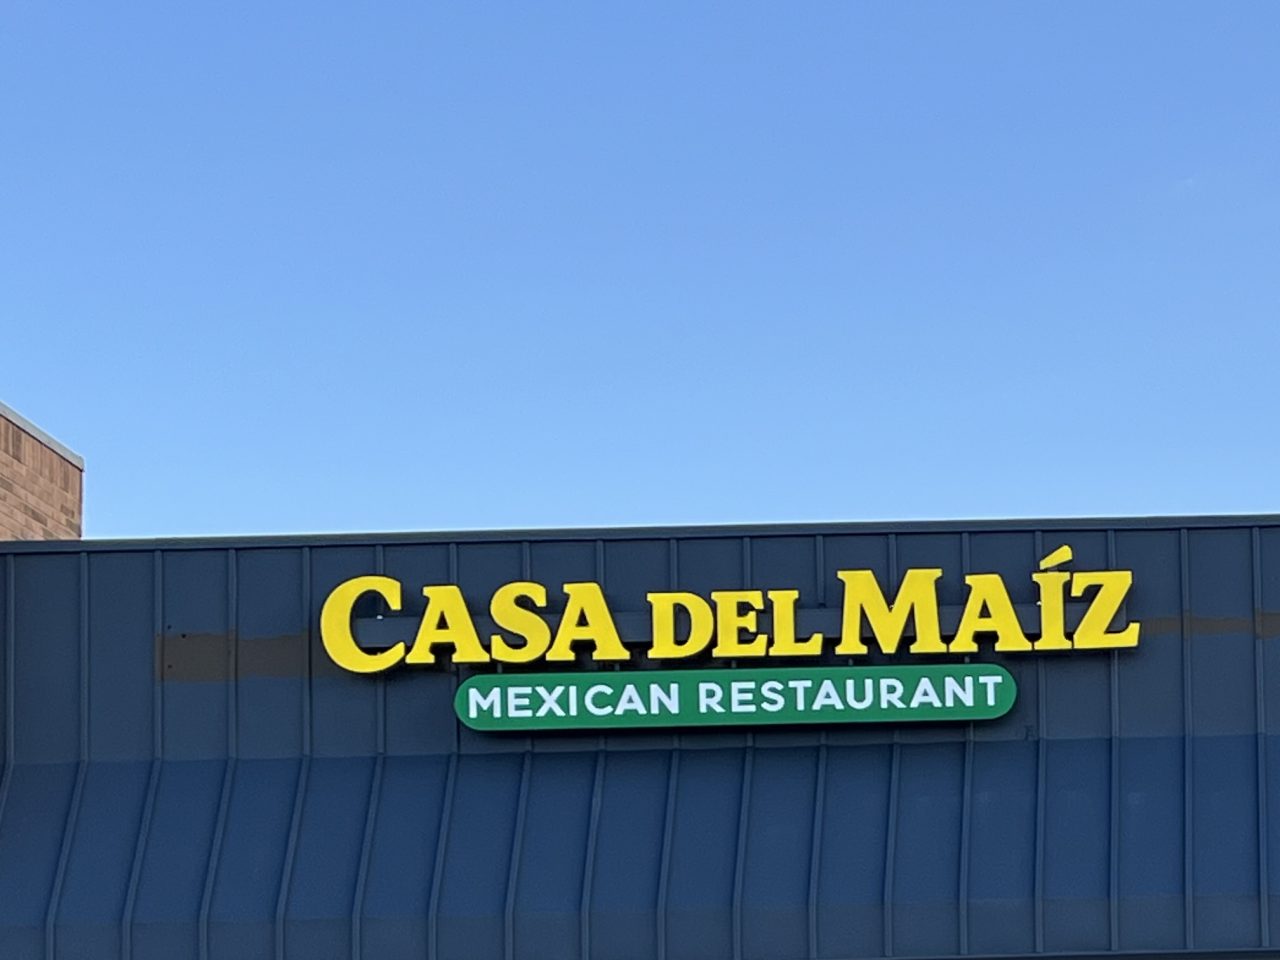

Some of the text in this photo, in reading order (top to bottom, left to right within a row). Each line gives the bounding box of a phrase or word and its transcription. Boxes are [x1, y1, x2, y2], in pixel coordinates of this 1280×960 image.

[648, 588, 824, 659] DEL
[467, 674, 1004, 720] MEXICAN RESTAURANT
